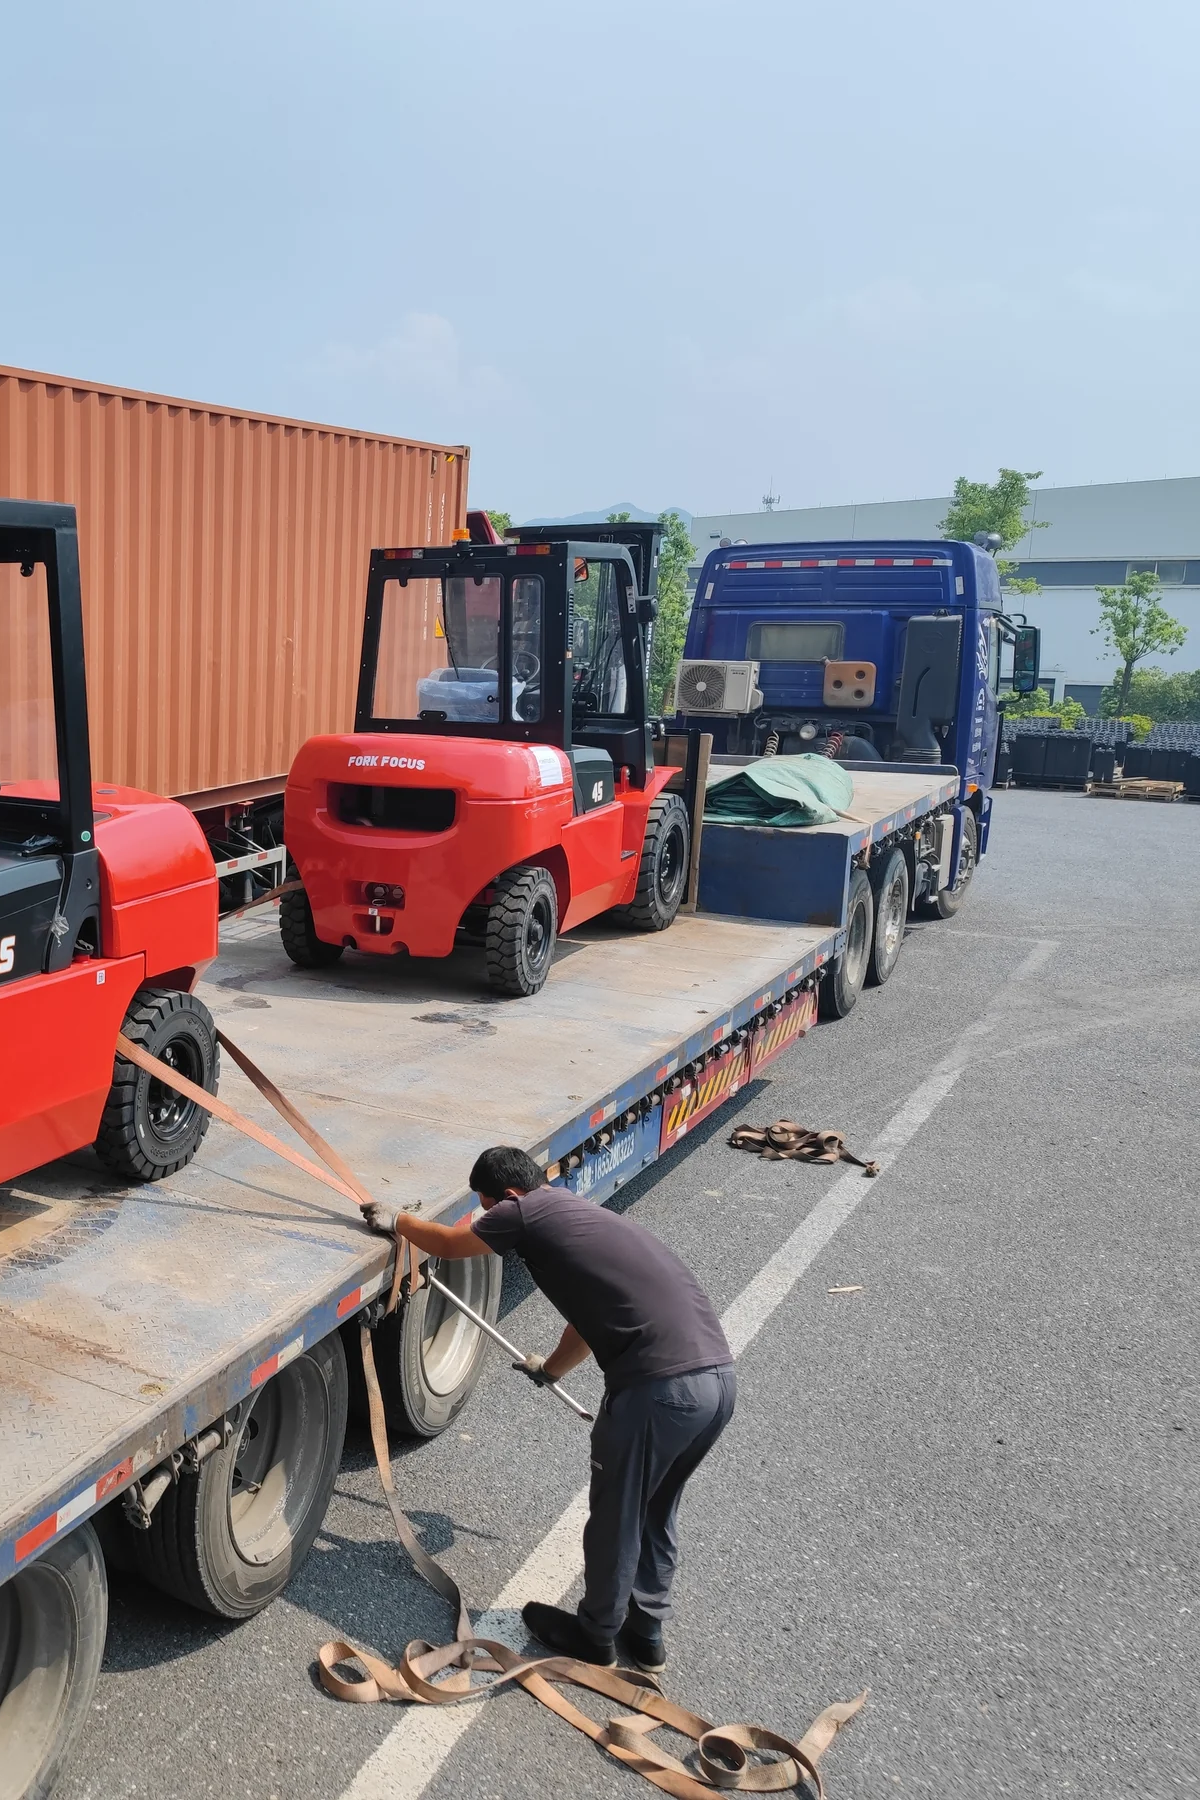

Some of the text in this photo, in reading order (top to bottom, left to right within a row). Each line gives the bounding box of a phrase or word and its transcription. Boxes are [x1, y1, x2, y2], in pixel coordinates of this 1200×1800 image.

[348, 755, 426, 771] FORK FOCUS
[591, 780, 604, 803] 45
